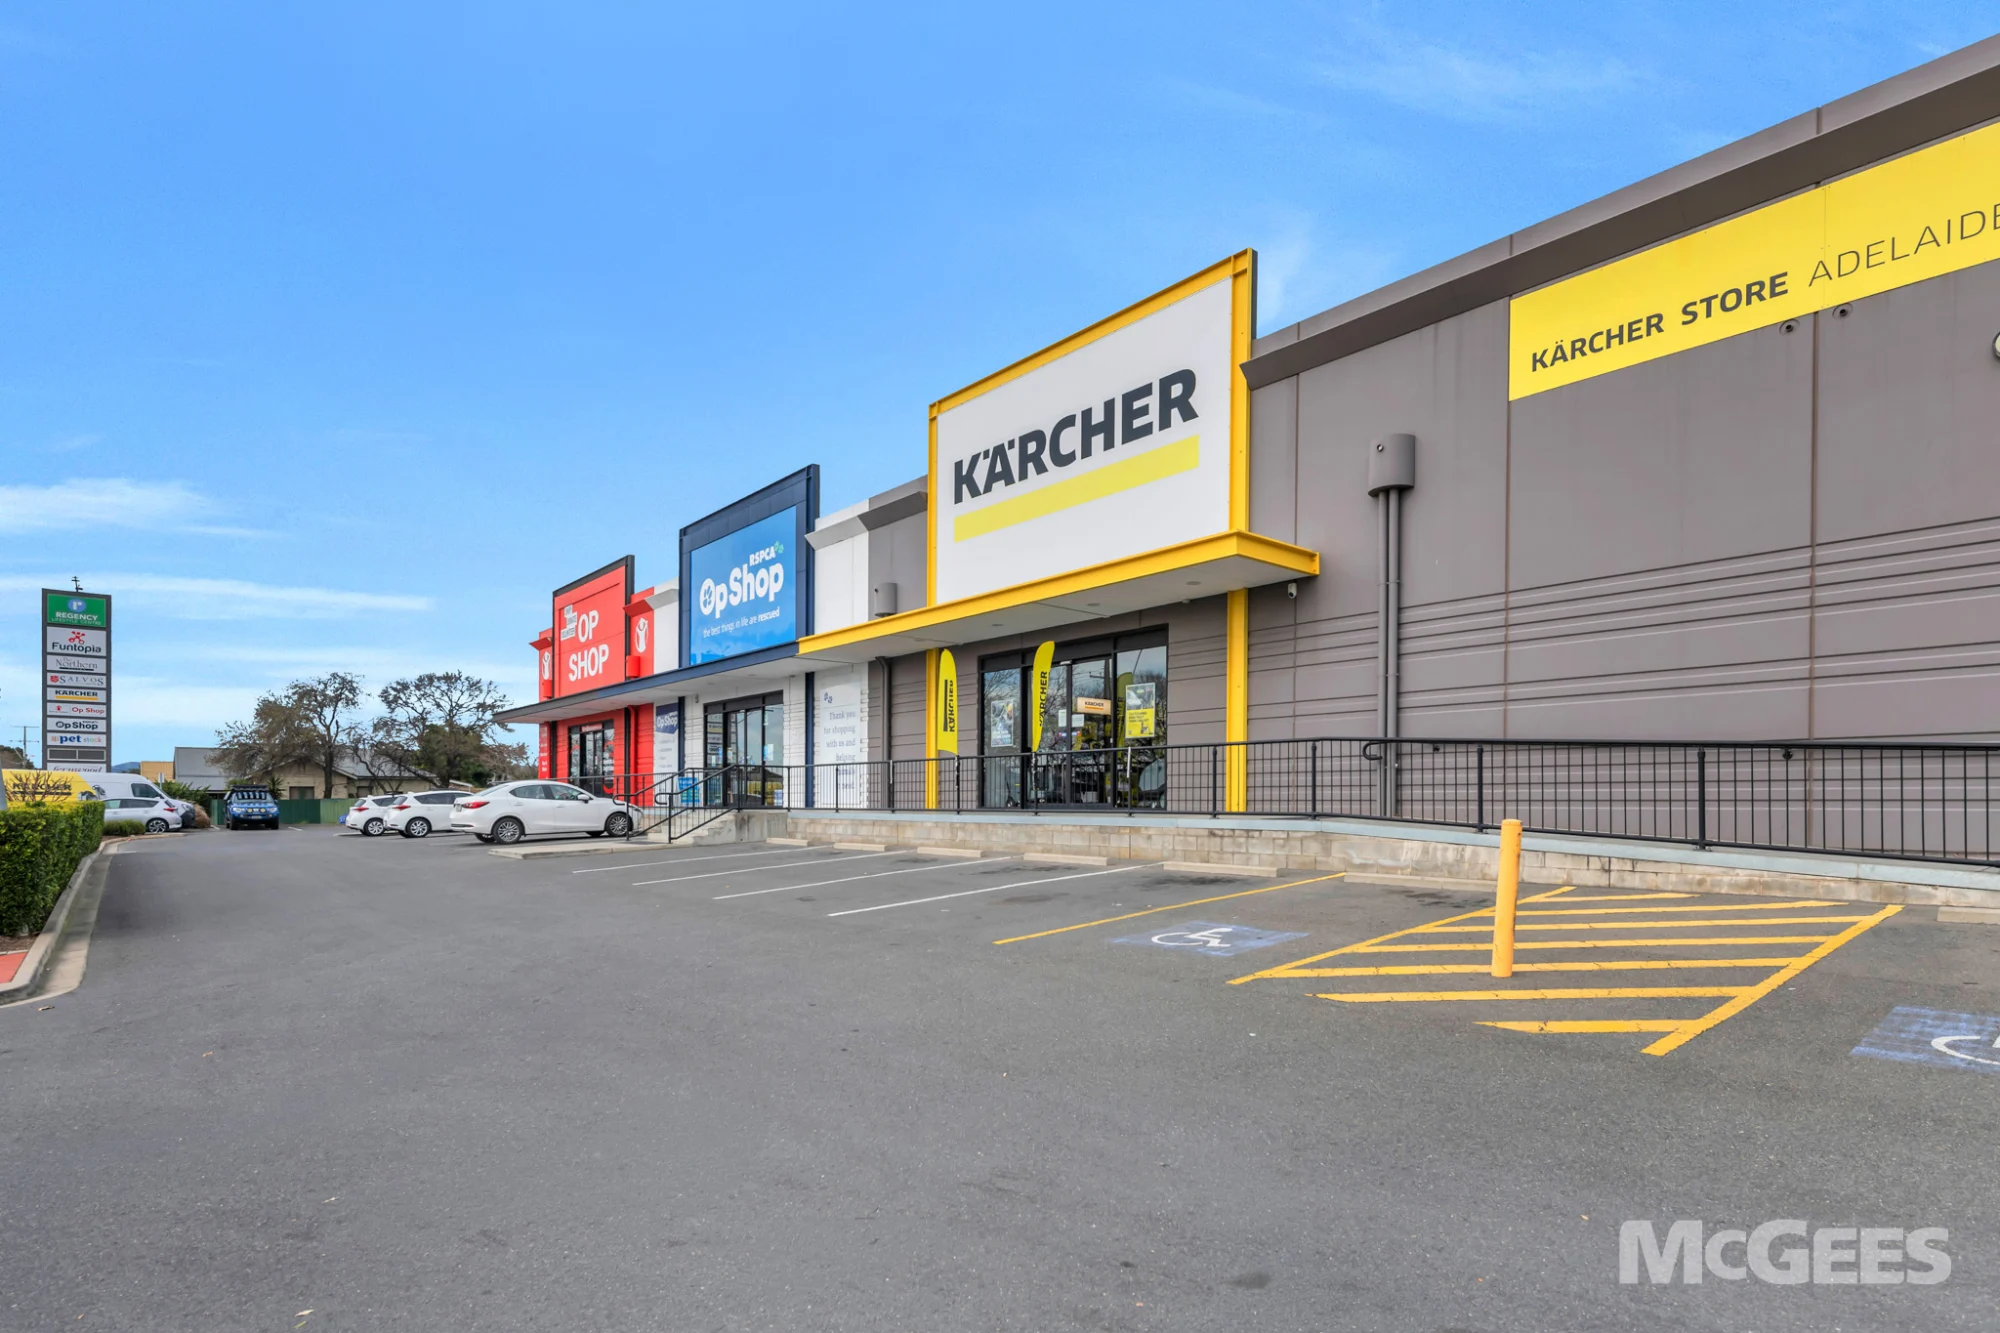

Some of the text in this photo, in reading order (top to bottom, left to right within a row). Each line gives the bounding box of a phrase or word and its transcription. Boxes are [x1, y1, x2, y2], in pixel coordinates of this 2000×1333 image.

[1531, 311, 1664, 374] KÄRCHER
[1681, 271, 1790, 327] STORE
[953, 368, 1199, 505] KÄRCHER
[749, 545, 776, 567] RSPCA
[55, 611, 99, 621] REGENCY
[703, 627, 711, 638] the
[711, 625, 721, 636] best
[721, 620, 735, 633] things
[740, 616, 749, 627] life
[749, 615, 757, 625] are
[758, 606, 780, 623] rescued
[577, 609, 599, 643] OP
[52, 641, 102, 653] Funtopia
[55, 658, 98, 669] Northern
[568, 643, 610, 682] SHOP
[59, 675, 104, 686] SALVOS
[71, 706, 84, 714] Op
[829, 711, 845, 721] Thank
[826, 740, 837, 748] with
[845, 738, 856, 747] and
